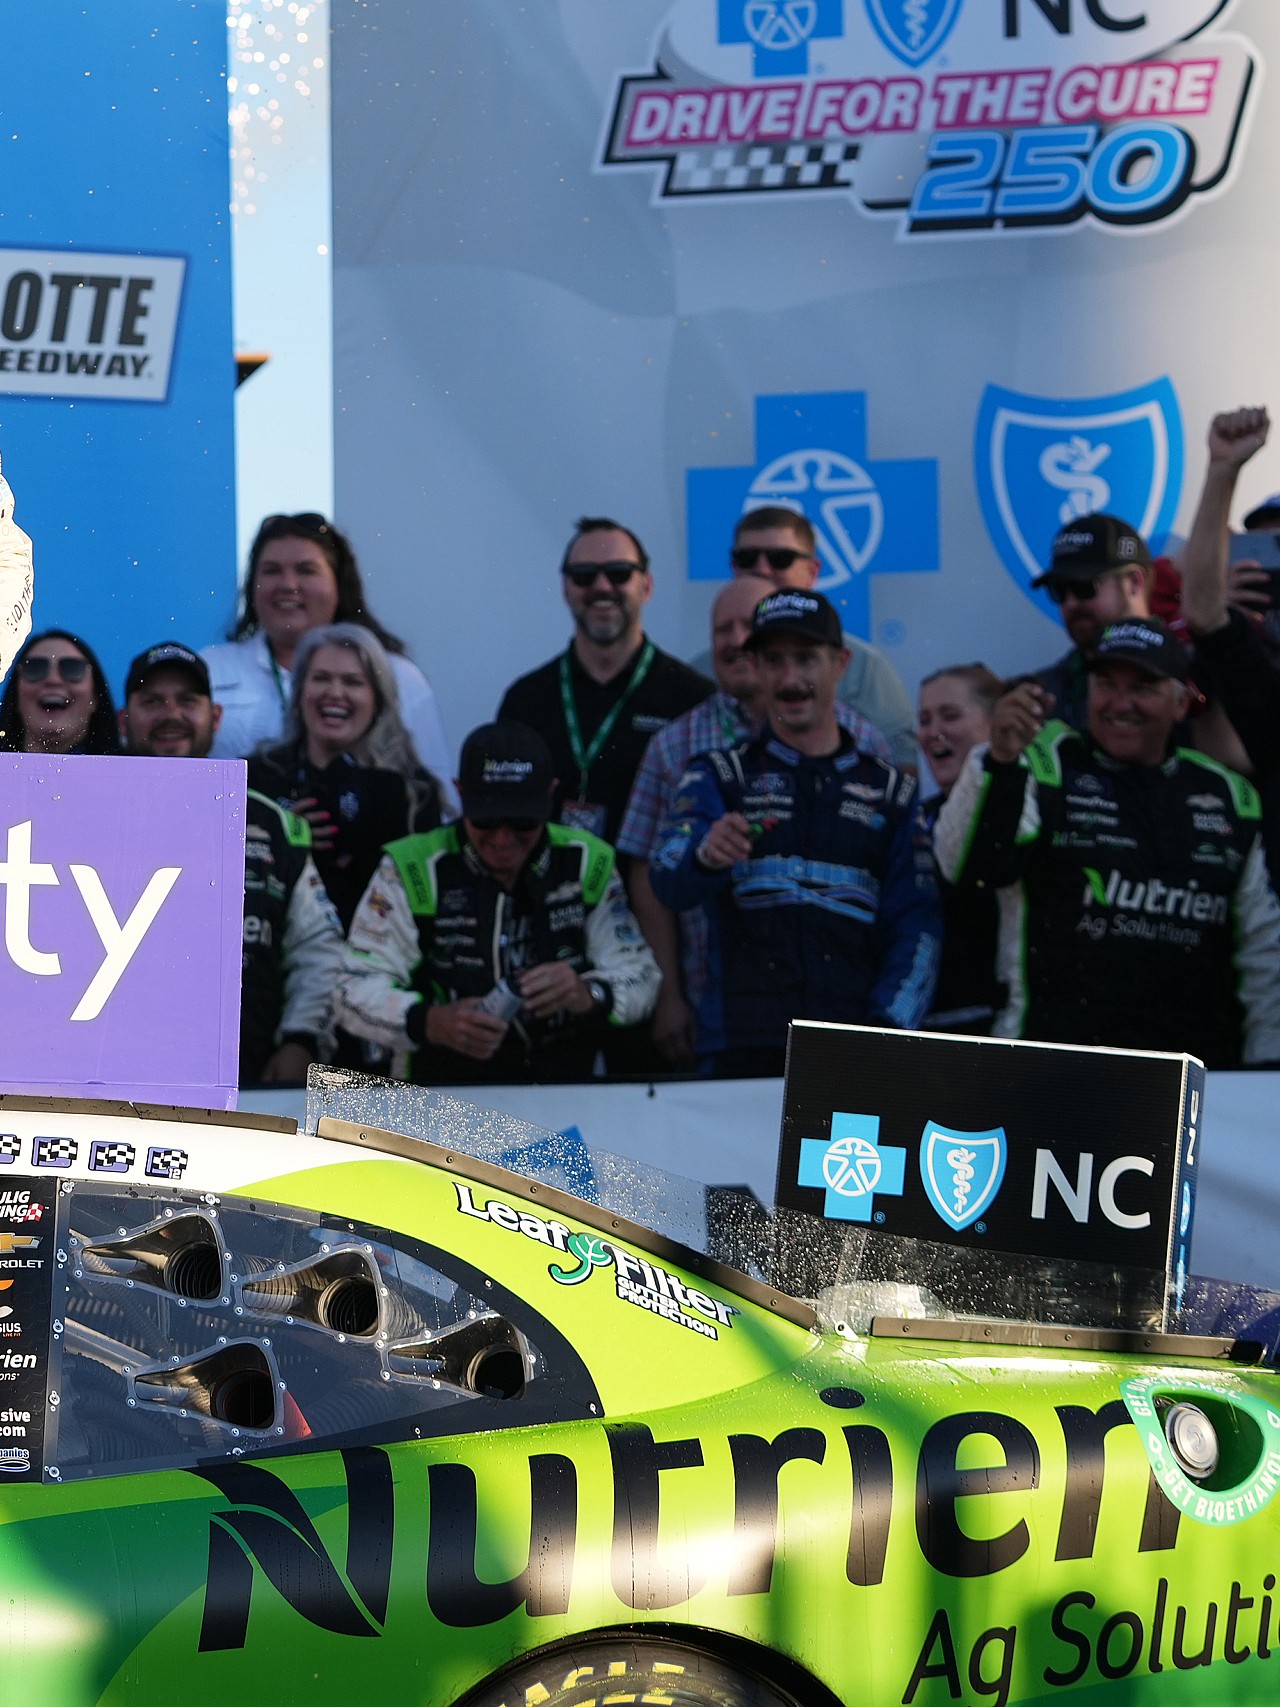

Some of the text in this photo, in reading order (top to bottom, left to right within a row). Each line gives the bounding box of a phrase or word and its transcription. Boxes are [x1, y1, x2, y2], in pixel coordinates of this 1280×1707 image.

[631, 61, 1218, 141] DRIVE FOR THE CURE
[910, 122, 1190, 220] 250
[1075, 912, 1108, 941] Ag
[1083, 867, 1228, 925] Nutrien
[1030, 1147, 1156, 1230] NC
[616, 1275, 680, 1311] GUTTER
[617, 1289, 718, 1340] PROTECTION
[195, 1387, 1180, 1653] Nutrien
[1165, 1468, 1196, 1508] GET
[901, 1573, 1278, 1707] Ag Soluti
